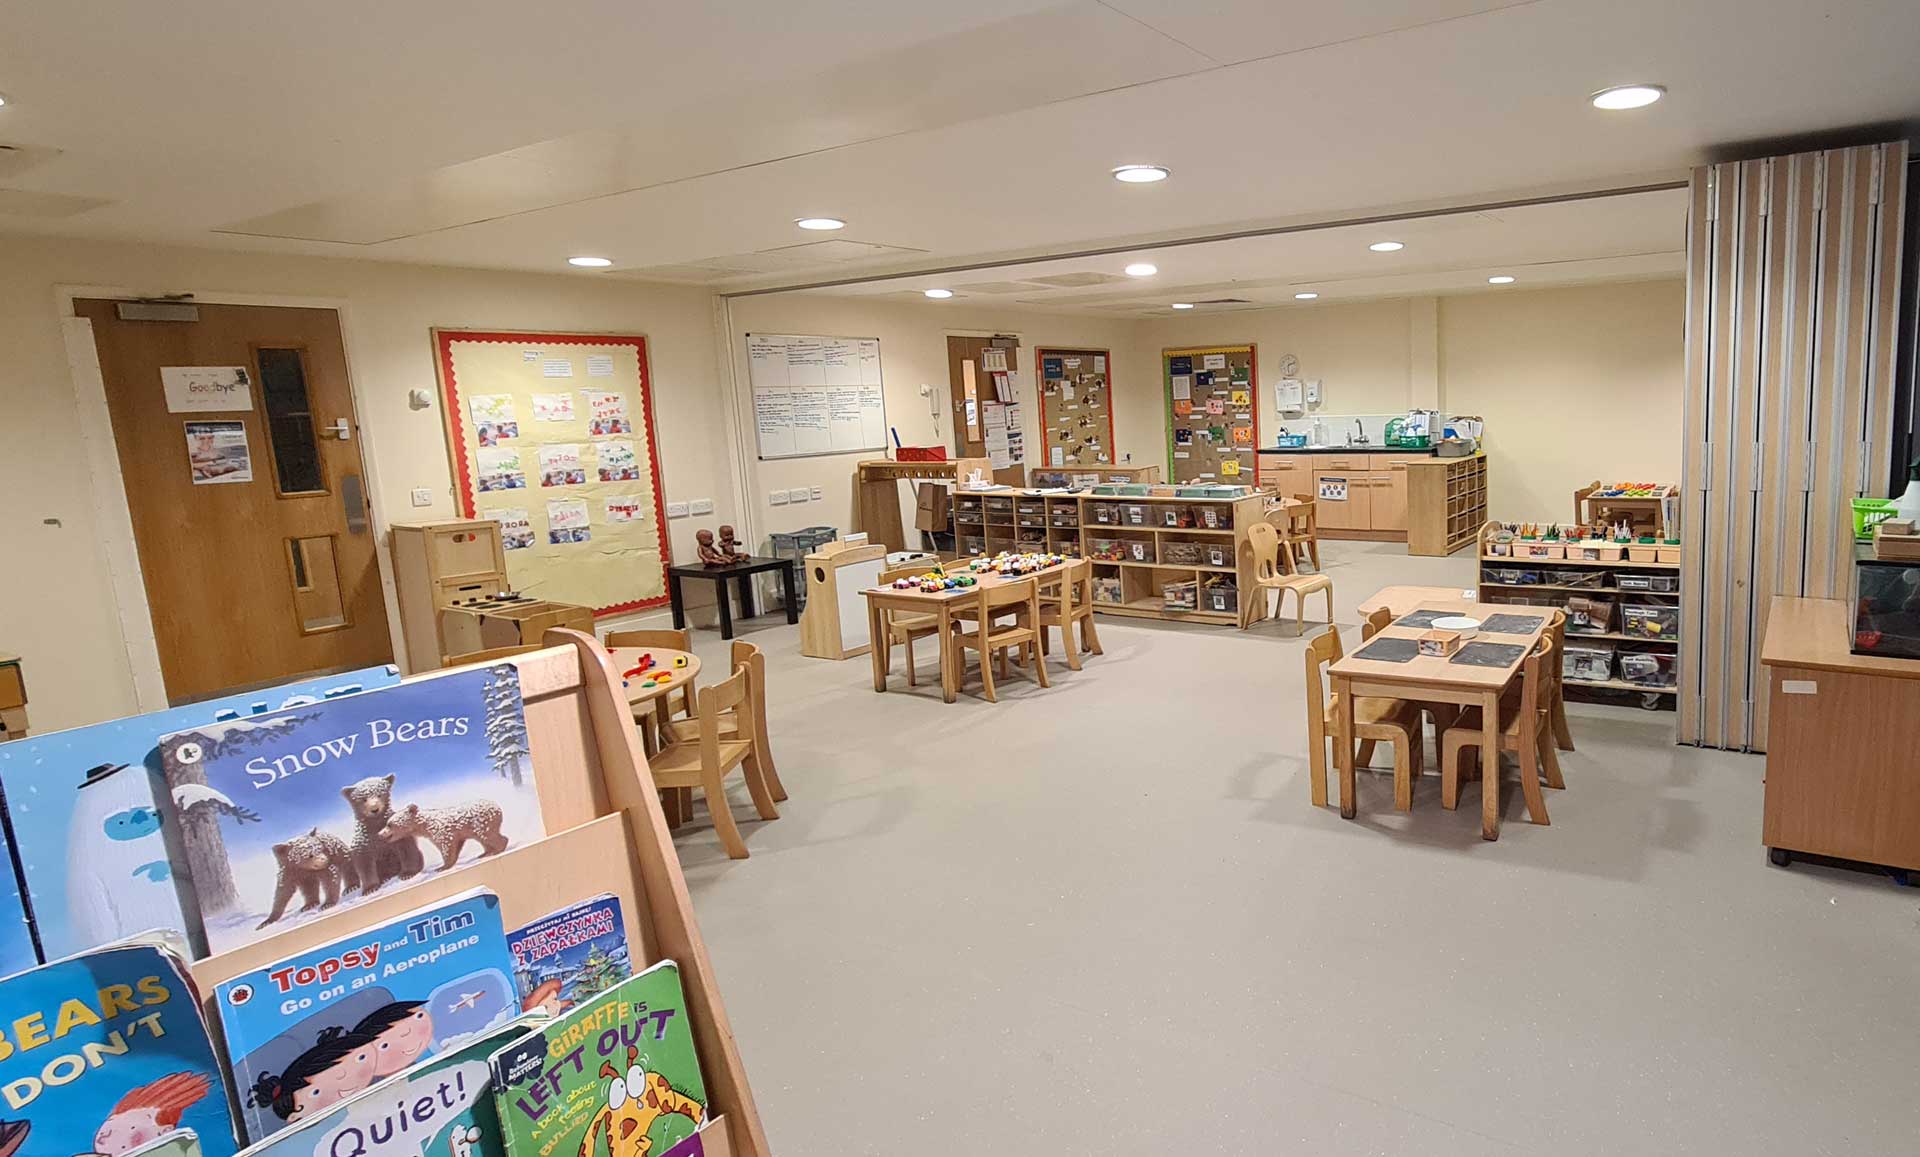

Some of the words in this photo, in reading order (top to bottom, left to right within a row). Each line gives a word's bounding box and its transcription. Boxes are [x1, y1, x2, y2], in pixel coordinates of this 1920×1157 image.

[189, 381, 236, 394] Goodbye
[245, 734, 359, 790] Snow
[367, 714, 469, 749] Bears
[271, 941, 380, 993] Topsy
[383, 935, 409, 952] and
[408, 911, 475, 945] Tim
[511, 907, 614, 956] DZIEWCZYNKA
[518, 954, 526, 966] Z
[532, 920, 614, 961] ZAPAŁKAMI
[280, 996, 312, 1016] Go
[319, 983, 345, 1001] on
[352, 971, 377, 988] an
[383, 934, 480, 978] Aeroplane
[1, 1011, 167, 1111] DON'T
[515, 1045, 585, 1121] LEFT
[596, 1009, 675, 1057] OUT
[330, 1070, 467, 1157] Quiet!
[537, 1104, 562, 1130] book
[566, 1081, 597, 1104] about
[538, 1111, 589, 1156] BULLIED
[558, 1096, 595, 1125] feeling
